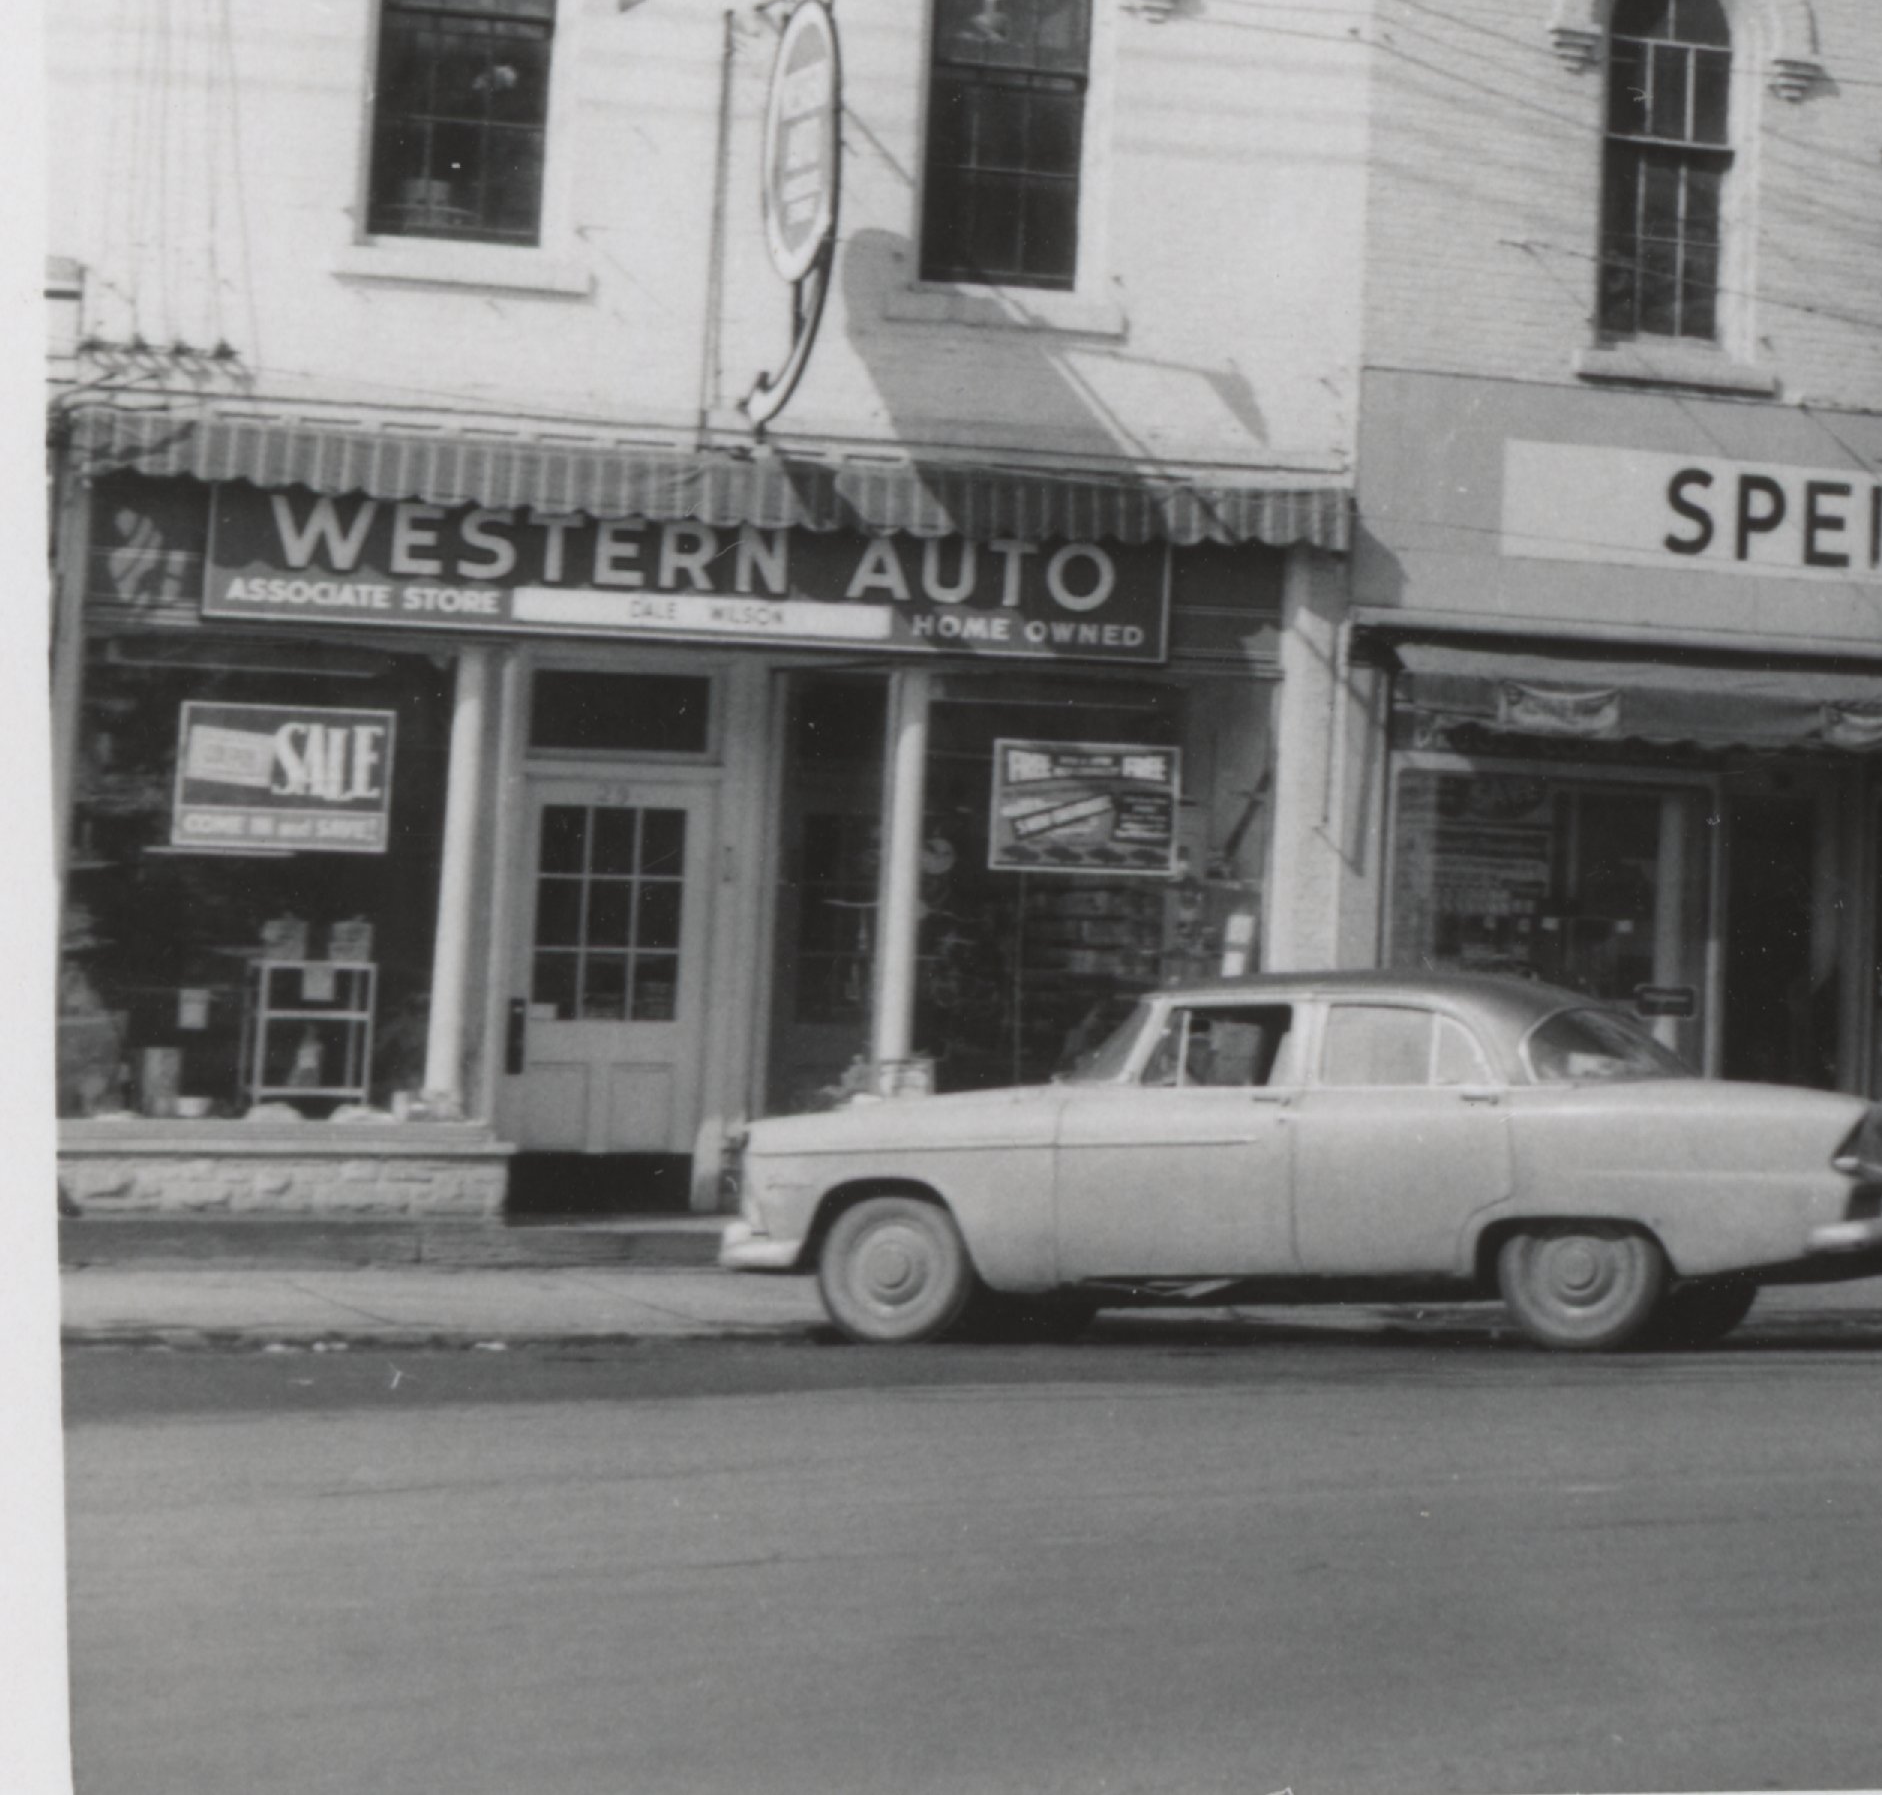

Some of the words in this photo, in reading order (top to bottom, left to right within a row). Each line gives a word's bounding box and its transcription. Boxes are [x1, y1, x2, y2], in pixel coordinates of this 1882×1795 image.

[271, 493, 789, 595] WESTERN
[846, 537, 1116, 612] AUTO
[225, 576, 393, 608] ASSOCIATE
[402, 585, 500, 613] STORE
[709, 604, 786, 627] WILSON
[911, 613, 1011, 642] HOME
[1023, 617, 1144, 647] OWNED
[271, 721, 386, 802] SALE
[182, 812, 245, 836] COME
